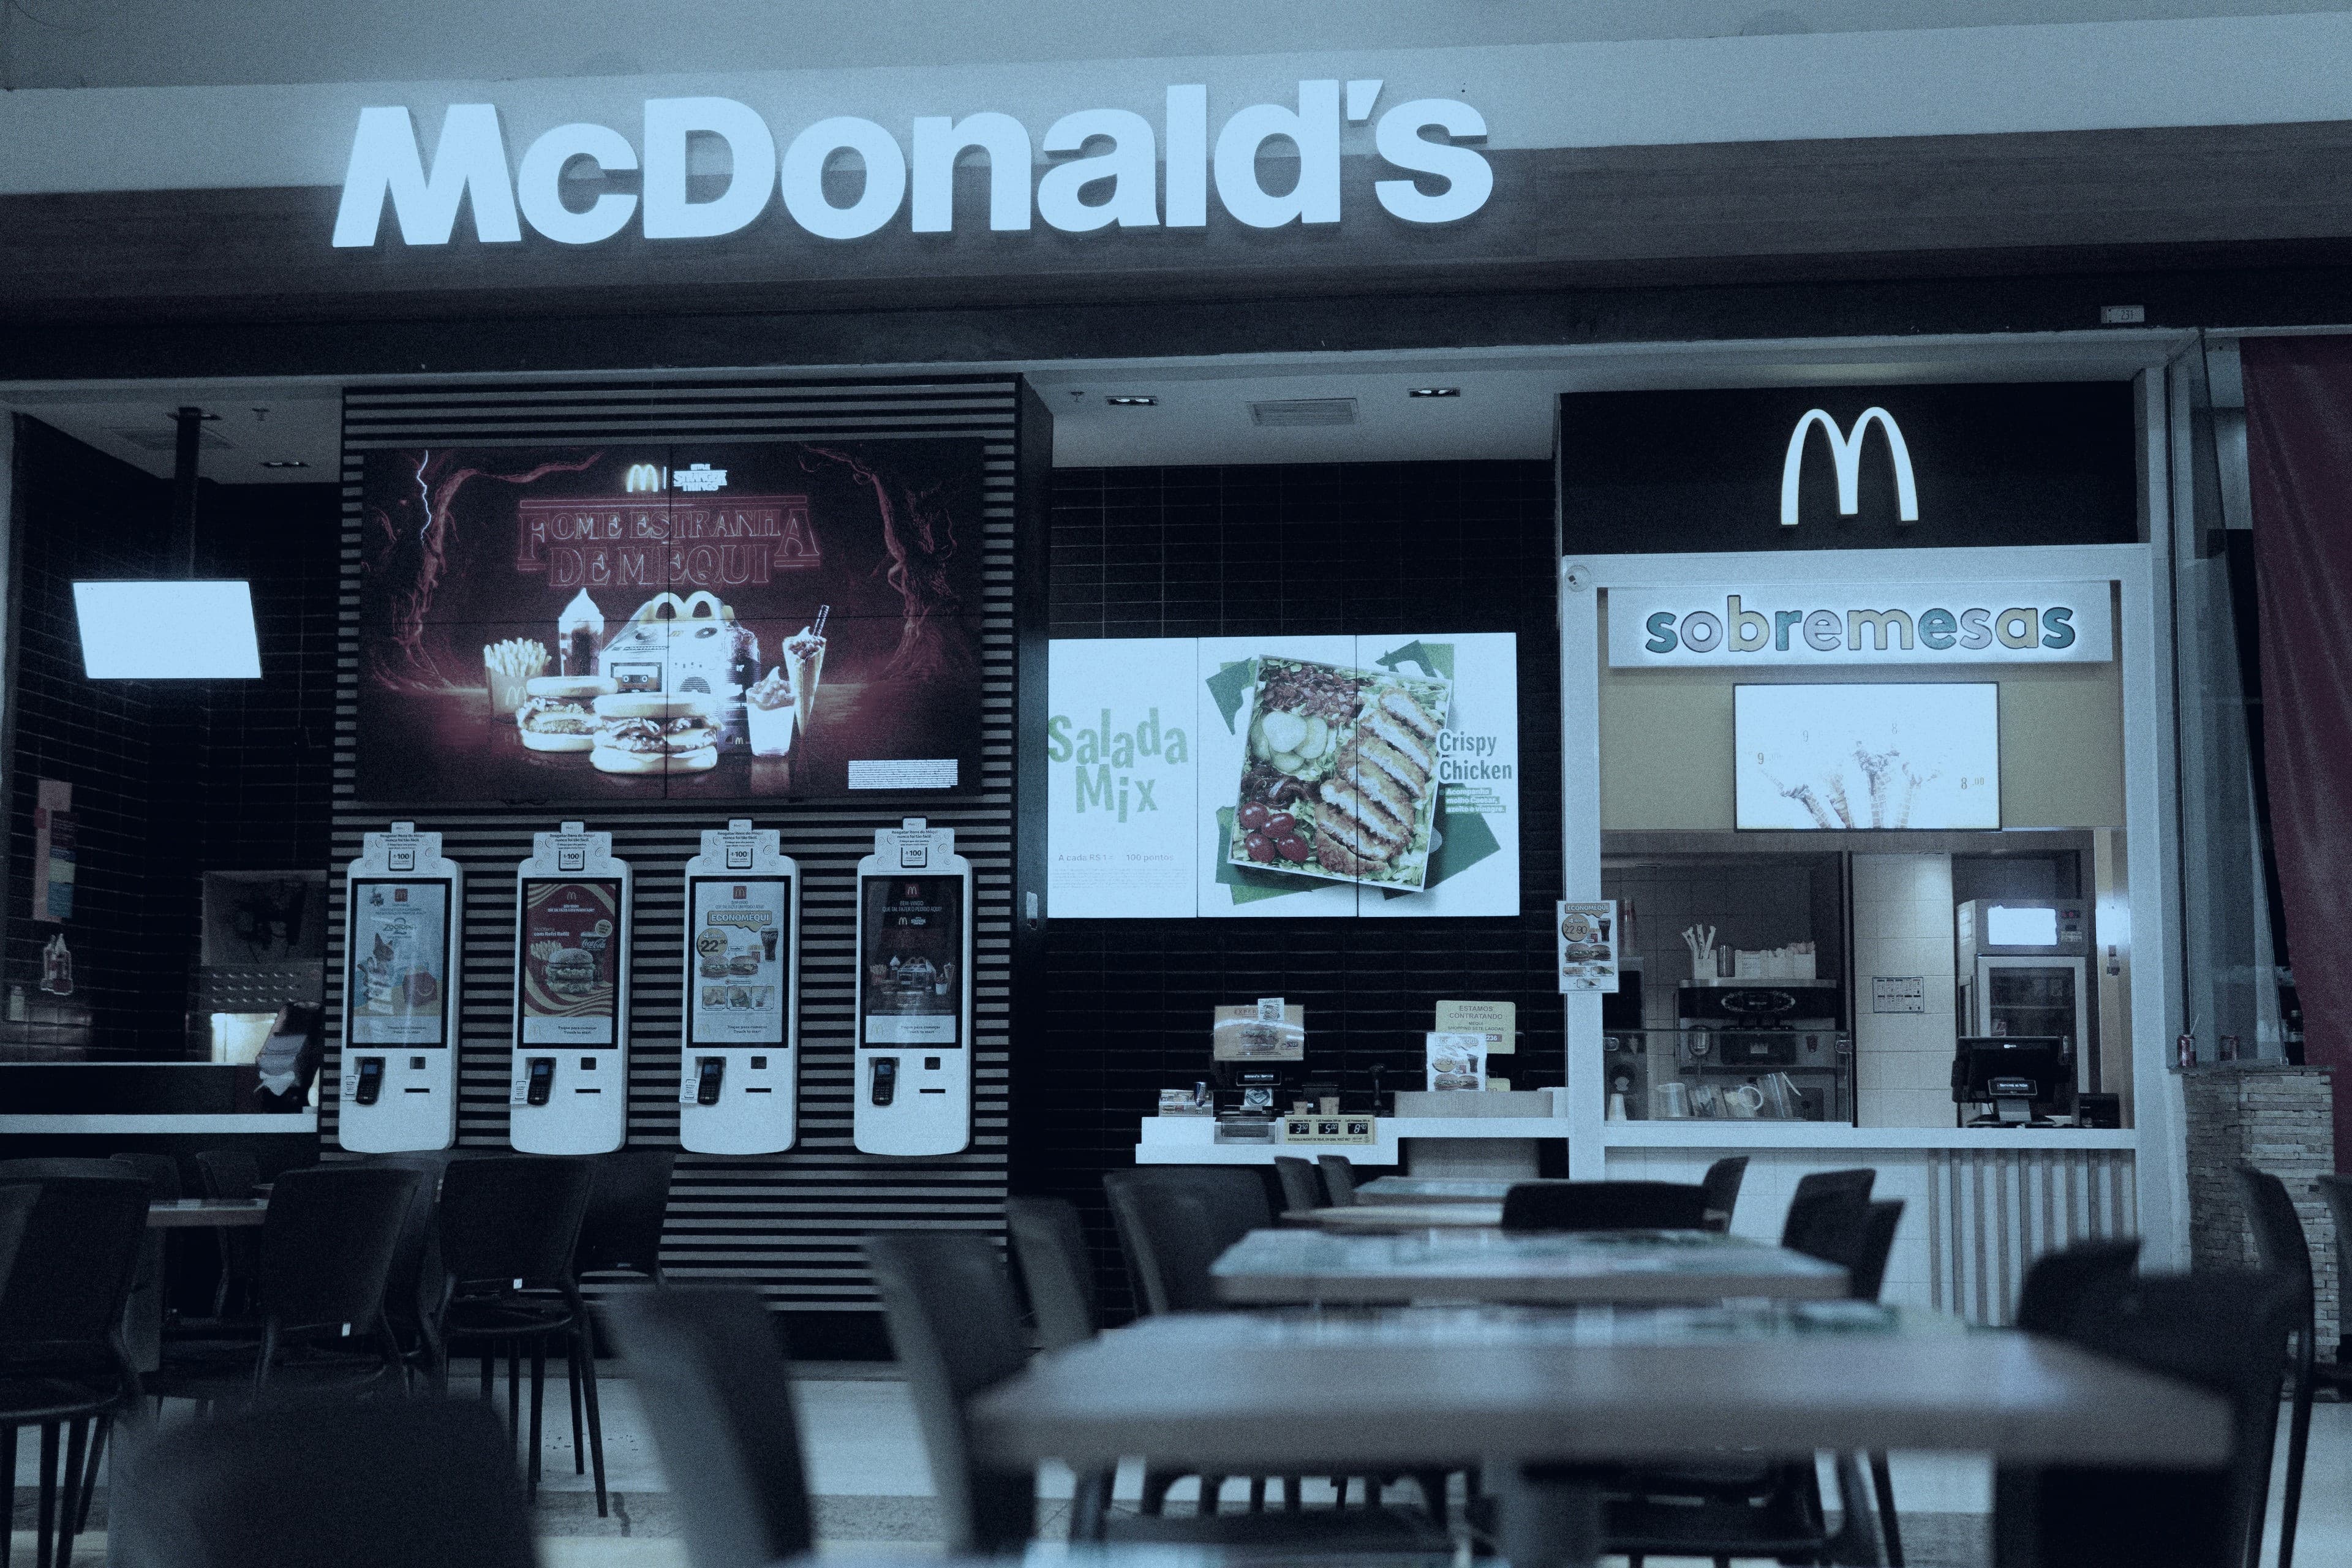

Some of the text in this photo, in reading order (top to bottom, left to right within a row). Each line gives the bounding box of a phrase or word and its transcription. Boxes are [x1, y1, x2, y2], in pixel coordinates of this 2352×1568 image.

[333, 79, 1493, 247] McDonald's
[518, 508, 820, 561] FOME ESTRANHA
[549, 546, 611, 586] DE
[1645, 595, 2076, 653] sobremesas
[1048, 707, 1188, 769] Salada
[1439, 731, 1497, 756] Crispy
[1439, 760, 1512, 780] Chicken
[1076, 764, 1158, 823] Mix
[1144, 854, 1174, 863] pontos
[710, 911, 769, 922] ECONOMÉQUI
